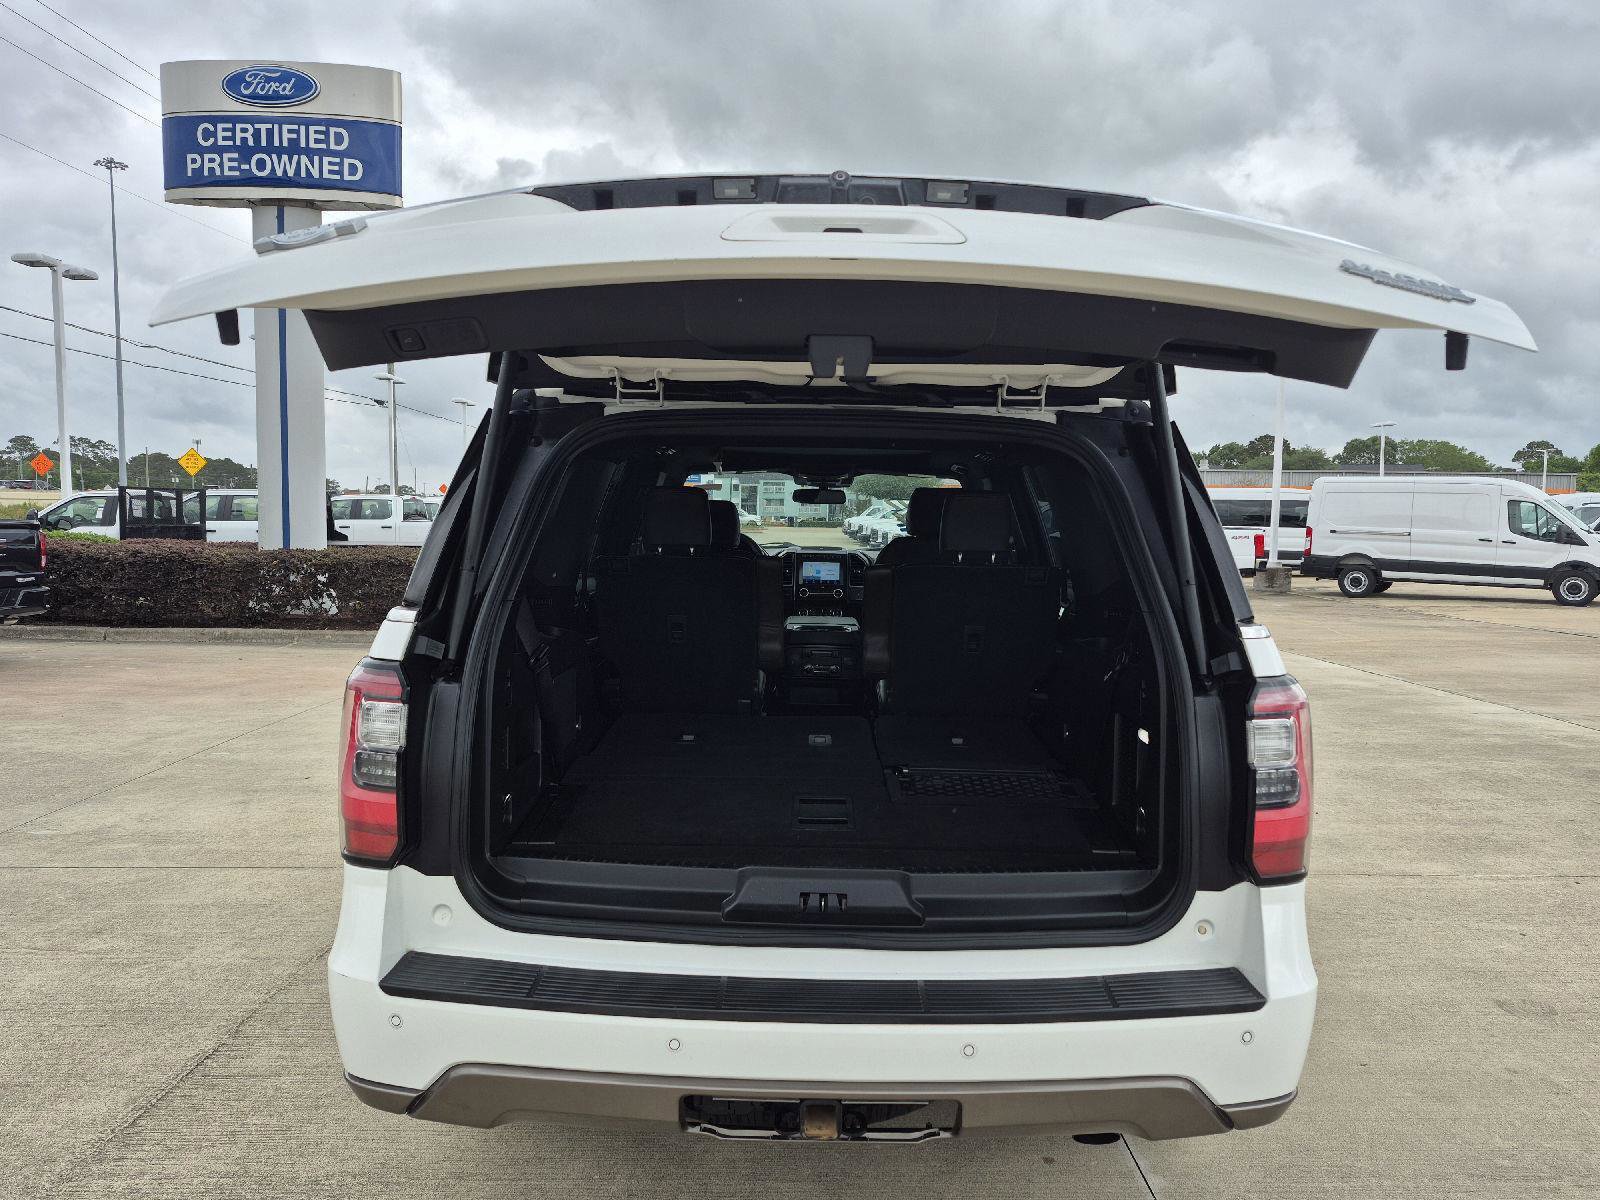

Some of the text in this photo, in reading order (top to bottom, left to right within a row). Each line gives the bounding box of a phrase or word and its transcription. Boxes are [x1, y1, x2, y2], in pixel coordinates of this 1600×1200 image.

[241, 70, 295, 95] Ford
[196, 122, 349, 151] CERTIFIED
[186, 153, 364, 181] PRE-OWNED
